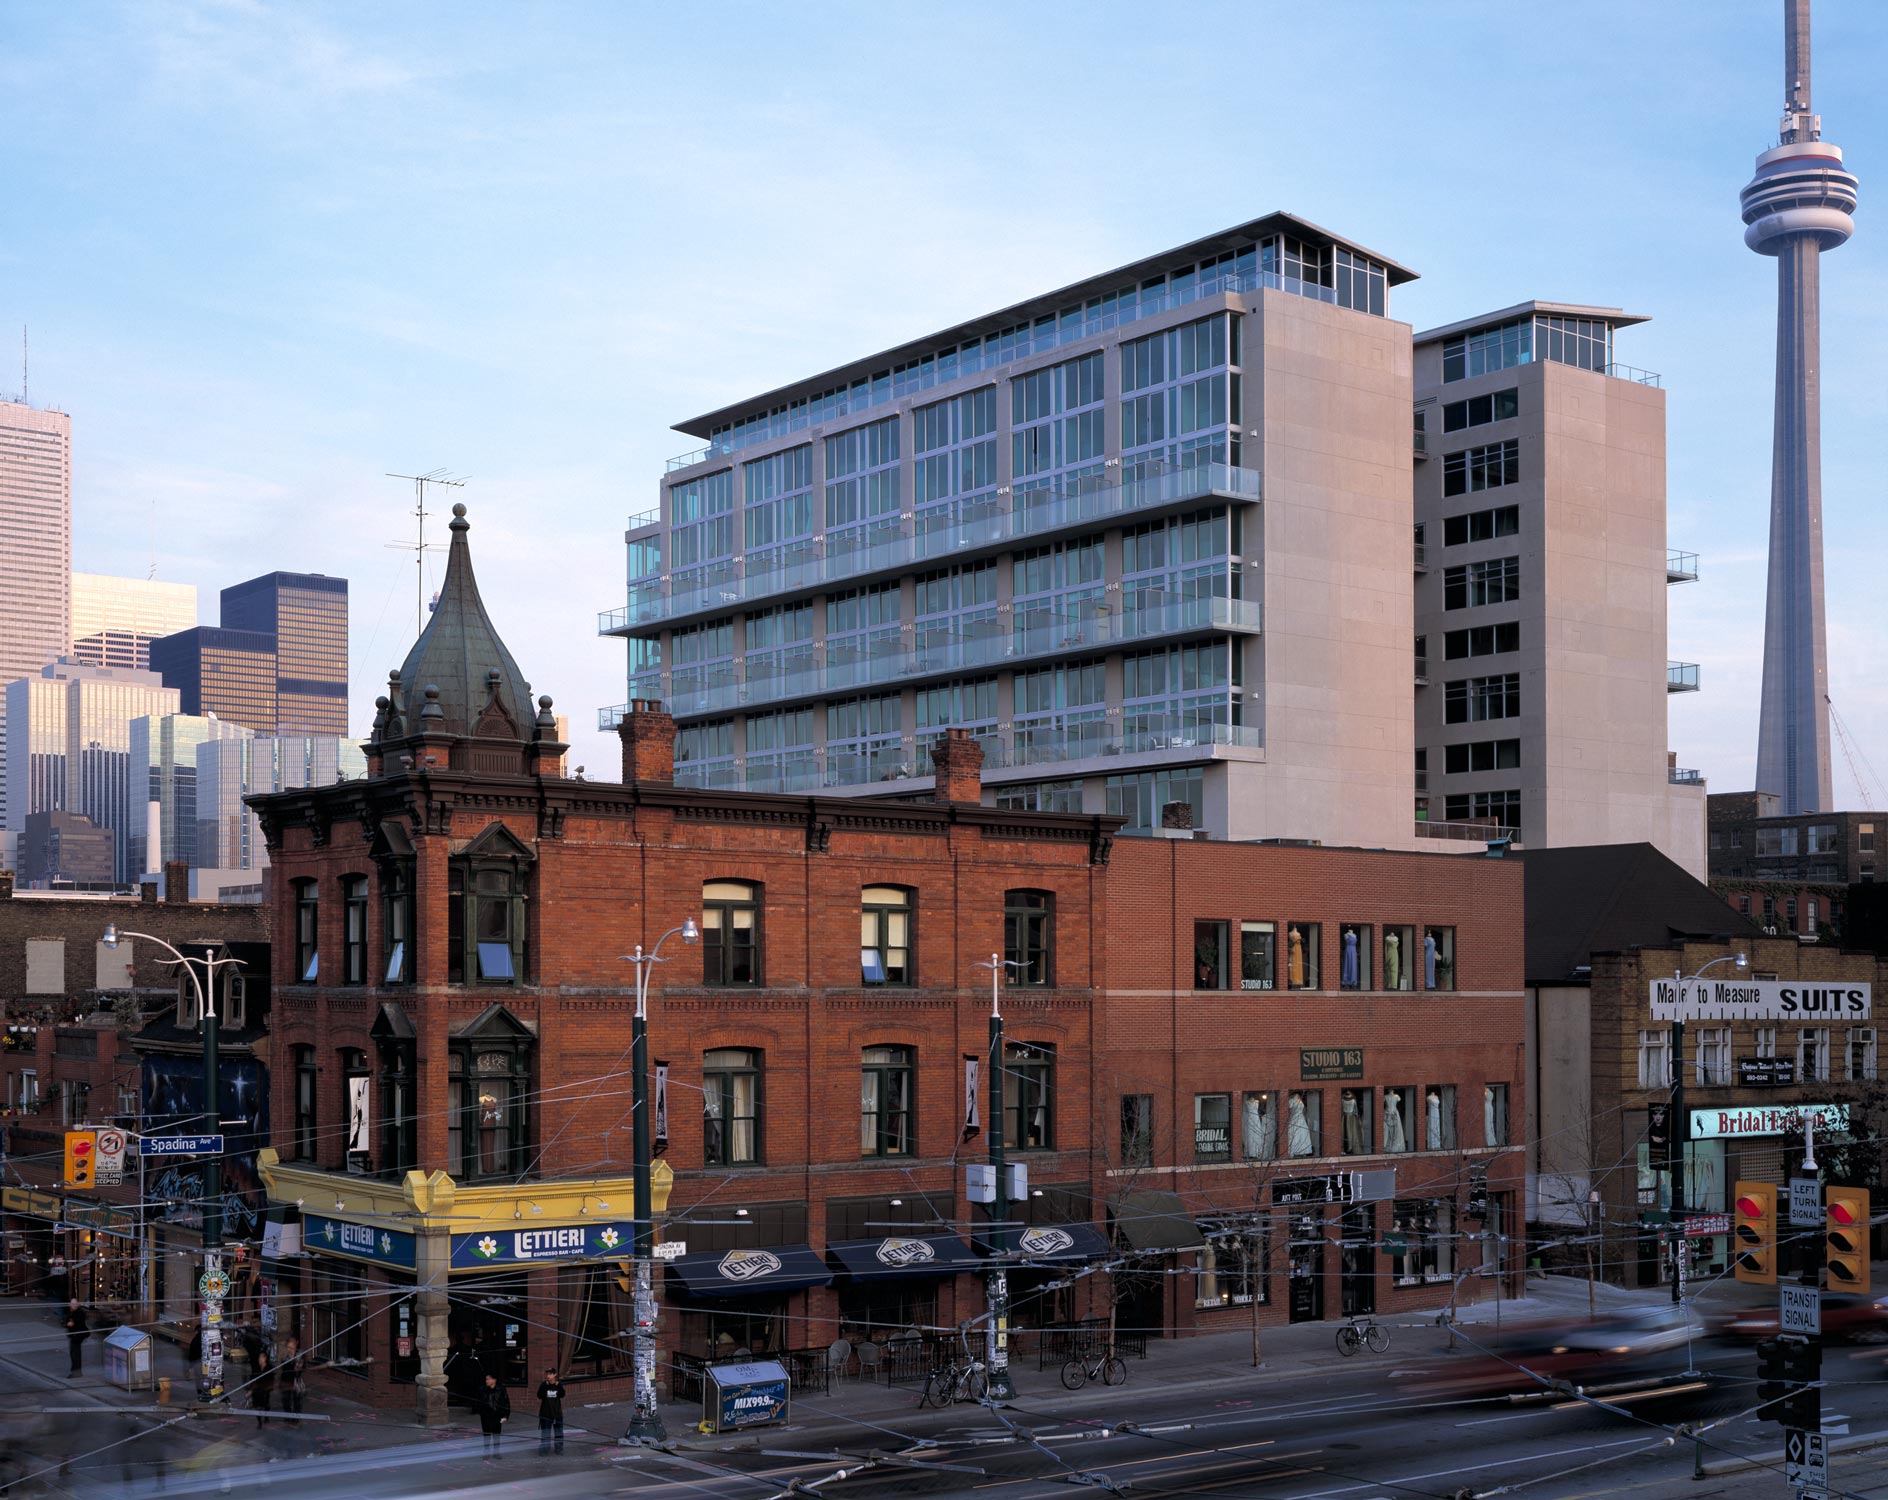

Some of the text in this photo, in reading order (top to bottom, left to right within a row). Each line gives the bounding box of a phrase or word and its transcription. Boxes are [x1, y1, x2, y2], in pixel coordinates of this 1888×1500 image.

[1262, 979, 1272, 989] 163
[1697, 984, 1708, 1004] to
[1715, 983, 1760, 1003] Measure
[1779, 988, 1864, 1012] SUITS
[1303, 1051, 1361, 1067] STUDIO 163
[1717, 1111, 1766, 1134] Bridal
[1196, 1128, 1227, 1142] BRIDAL
[151, 1139, 196, 1153] Spadina
[1794, 1185, 1815, 1195] LEFT
[1794, 1197, 1817, 1207] TURN
[1792, 1209, 1818, 1220] SIGNAL
[341, 1222, 374, 1249] LETTIERI
[514, 1229, 585, 1259] LETTIERI
[1025, 1231, 1065, 1252] LETTIERI
[881, 1242, 925, 1263] LETTIERI
[723, 1253, 772, 1278] LETTIERI
[1783, 1290, 1817, 1309] TRANSIT
[1785, 1309, 1815, 1328] SIGNAL
